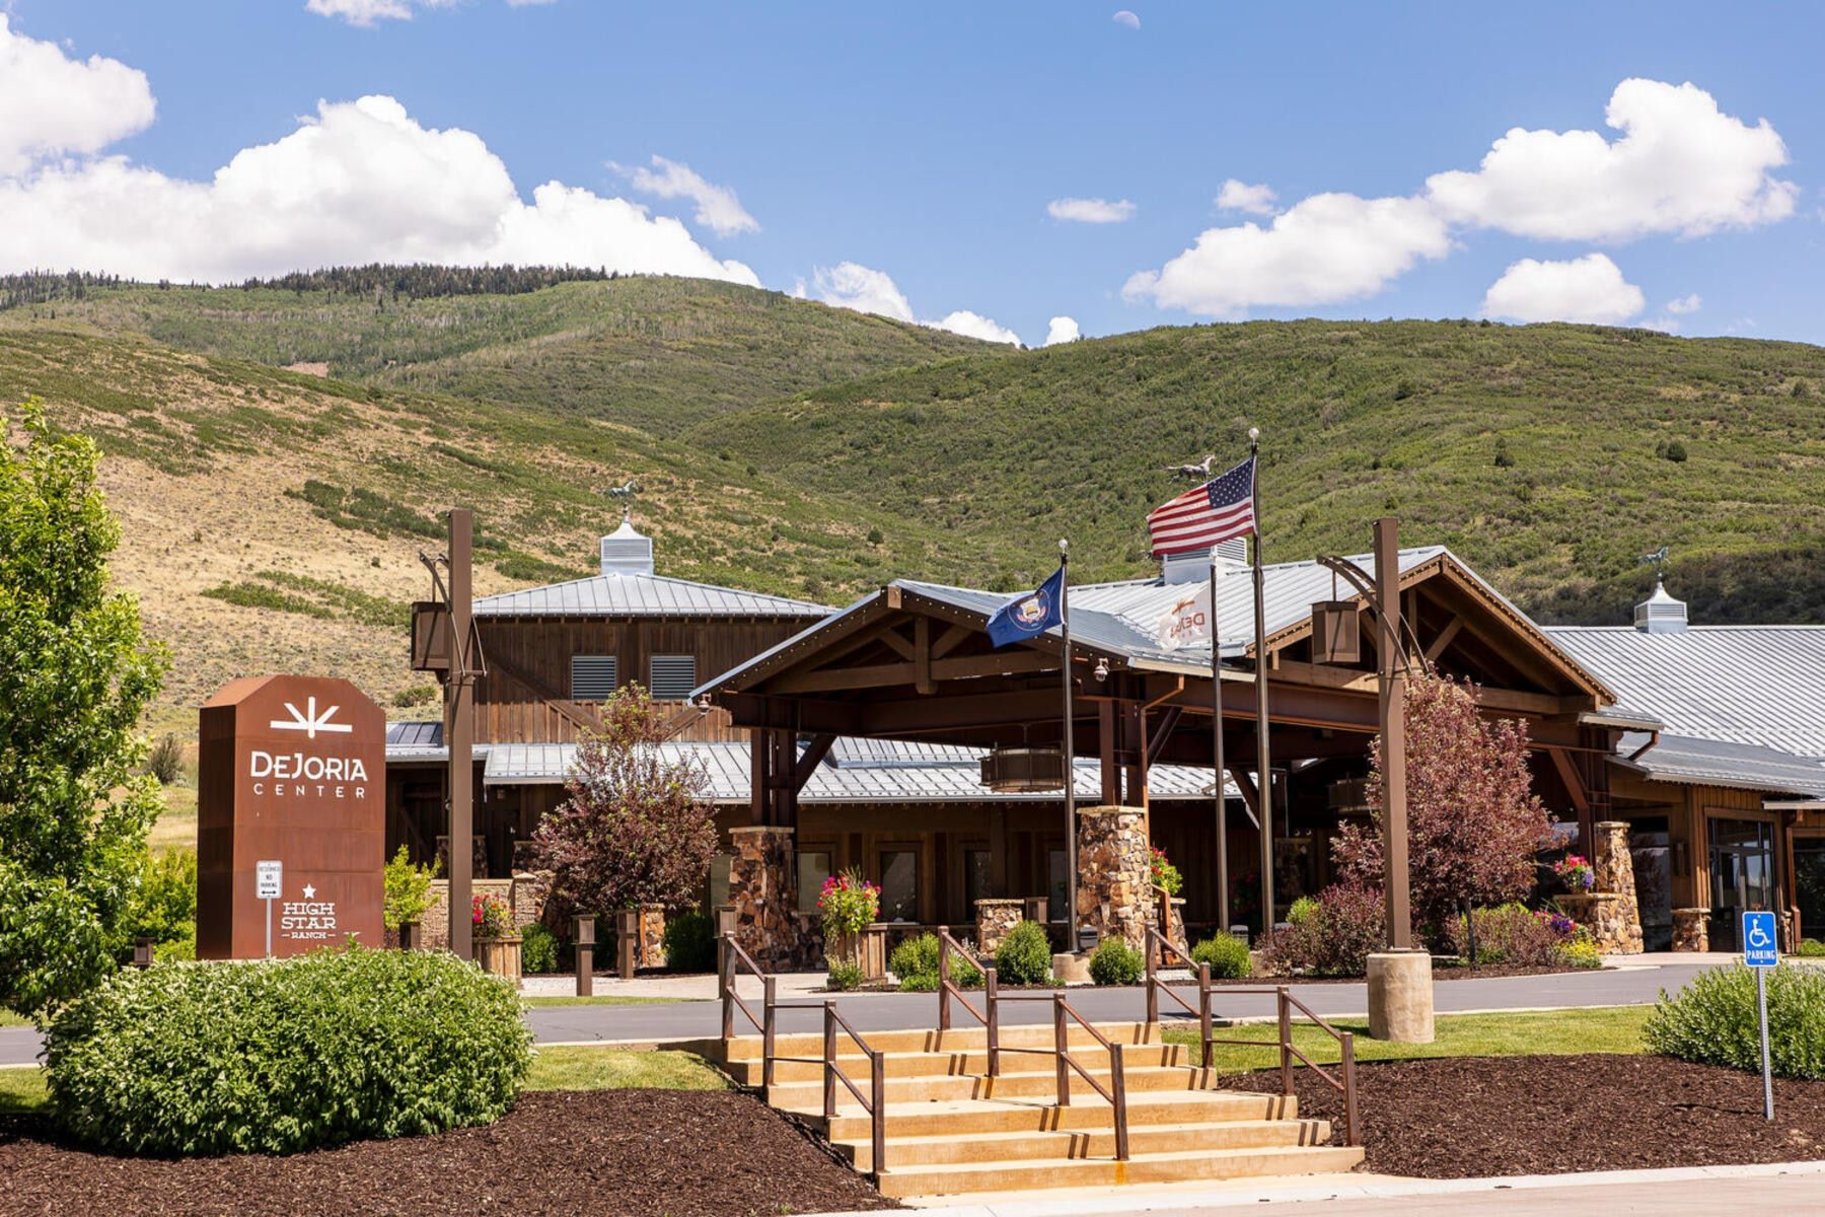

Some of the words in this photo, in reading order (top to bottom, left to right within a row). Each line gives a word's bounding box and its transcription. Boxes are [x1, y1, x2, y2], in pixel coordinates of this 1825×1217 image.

[250, 751, 368, 782] DEJORIA
[253, 783, 365, 799] CENTER
[282, 902, 336, 916] HIGH
[281, 916, 337, 930] STAR
[290, 931, 327, 939] RANCH
[1747, 949, 1776, 960] PARKING
